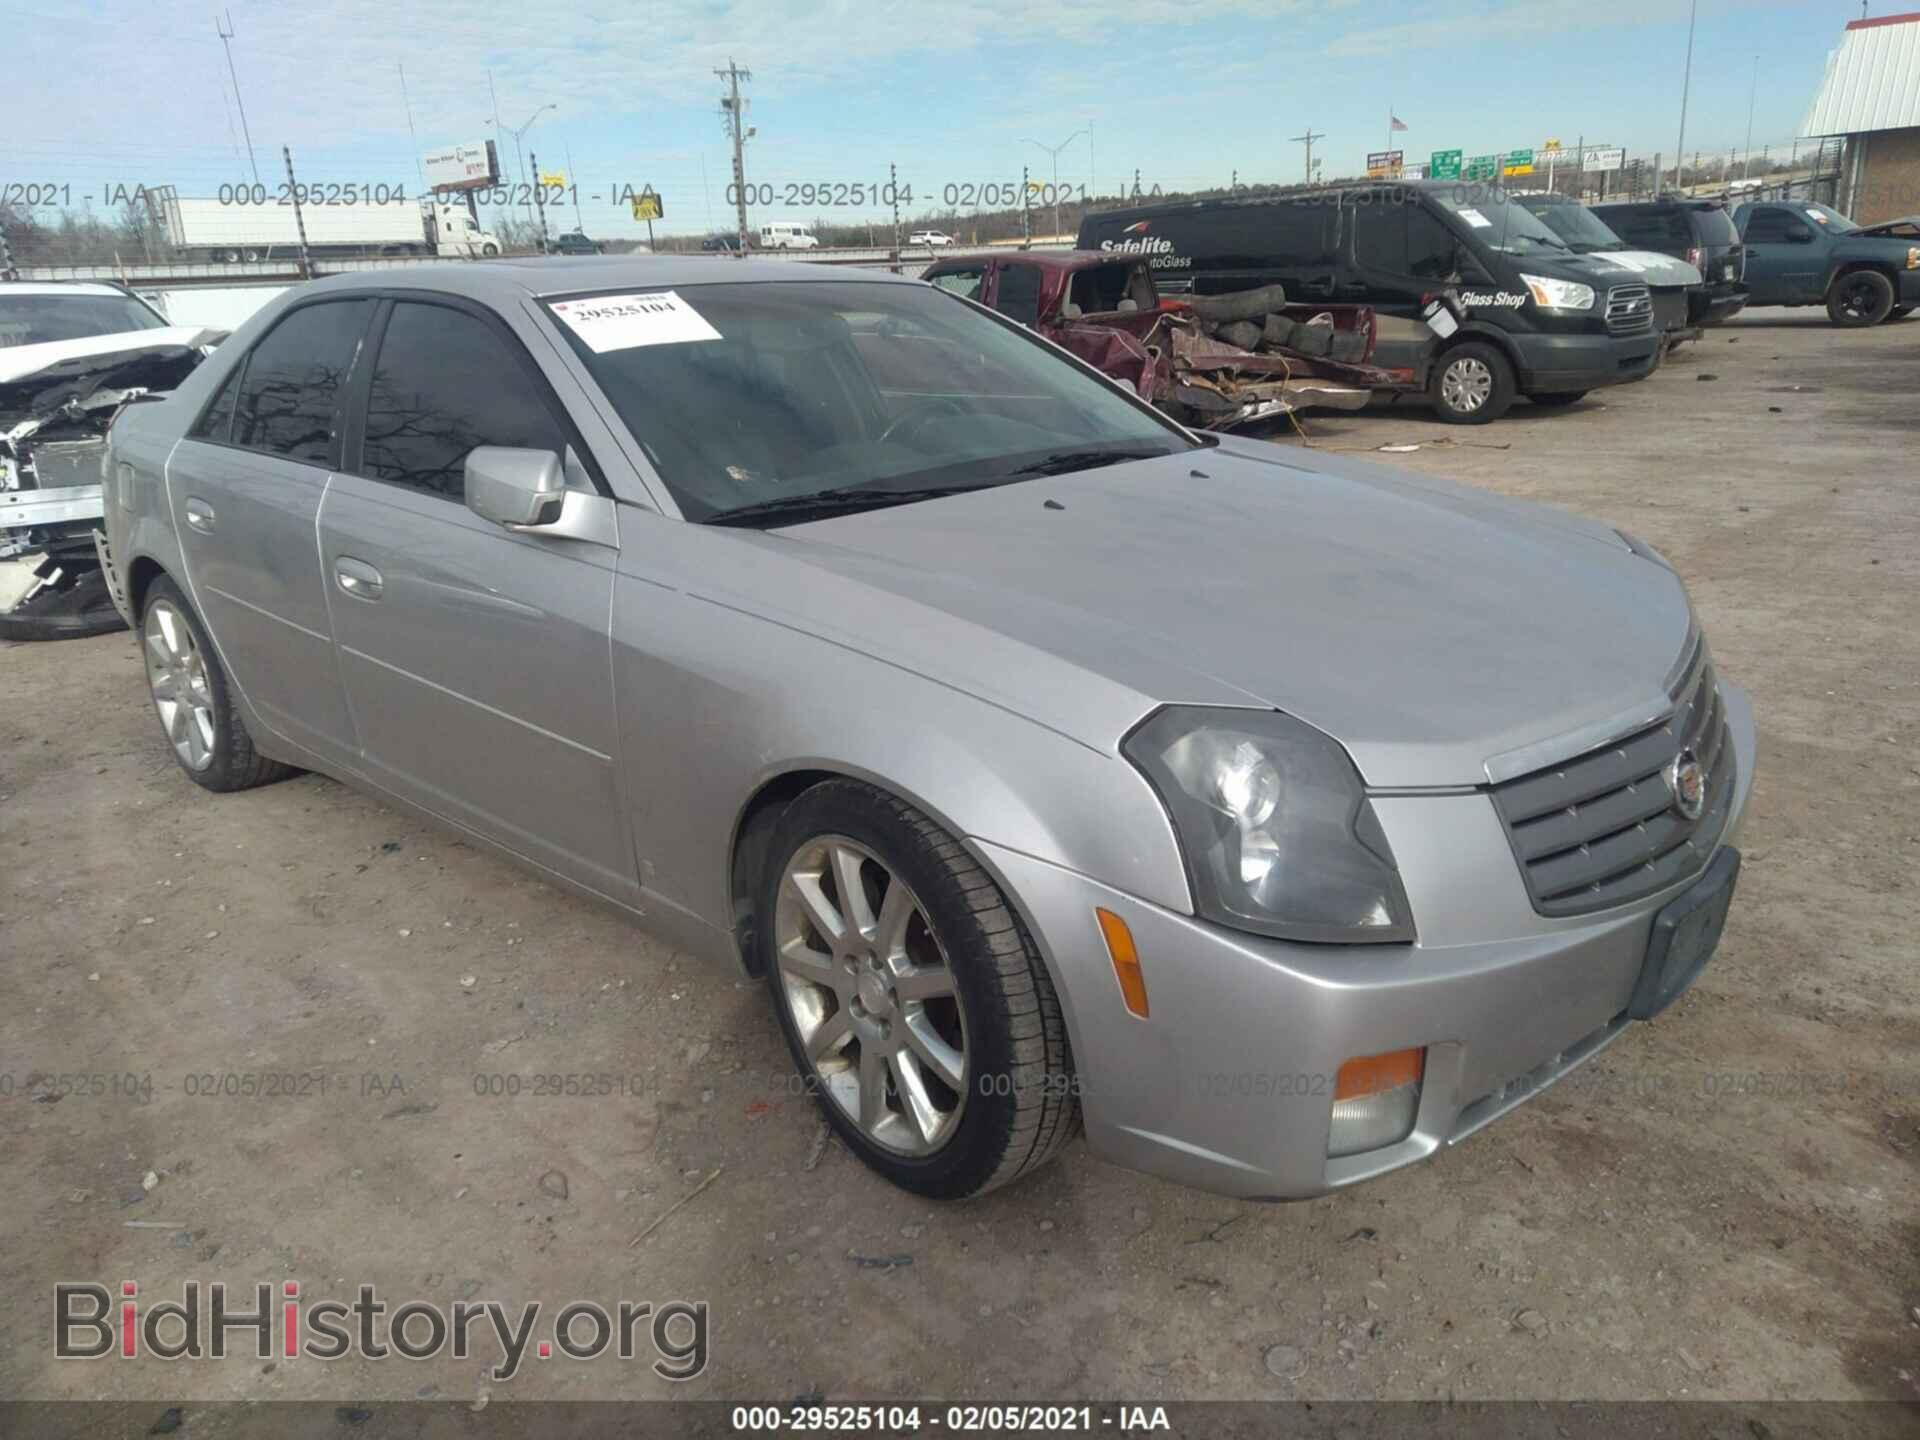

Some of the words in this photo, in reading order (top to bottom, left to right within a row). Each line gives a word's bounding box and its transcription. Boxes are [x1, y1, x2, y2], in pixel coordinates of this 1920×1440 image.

[1100, 237, 1172, 254] Safelite
[1150, 255, 1192, 269] toGlass
[1461, 291, 1494, 306] Glass
[1494, 291, 1525, 309] Shop
